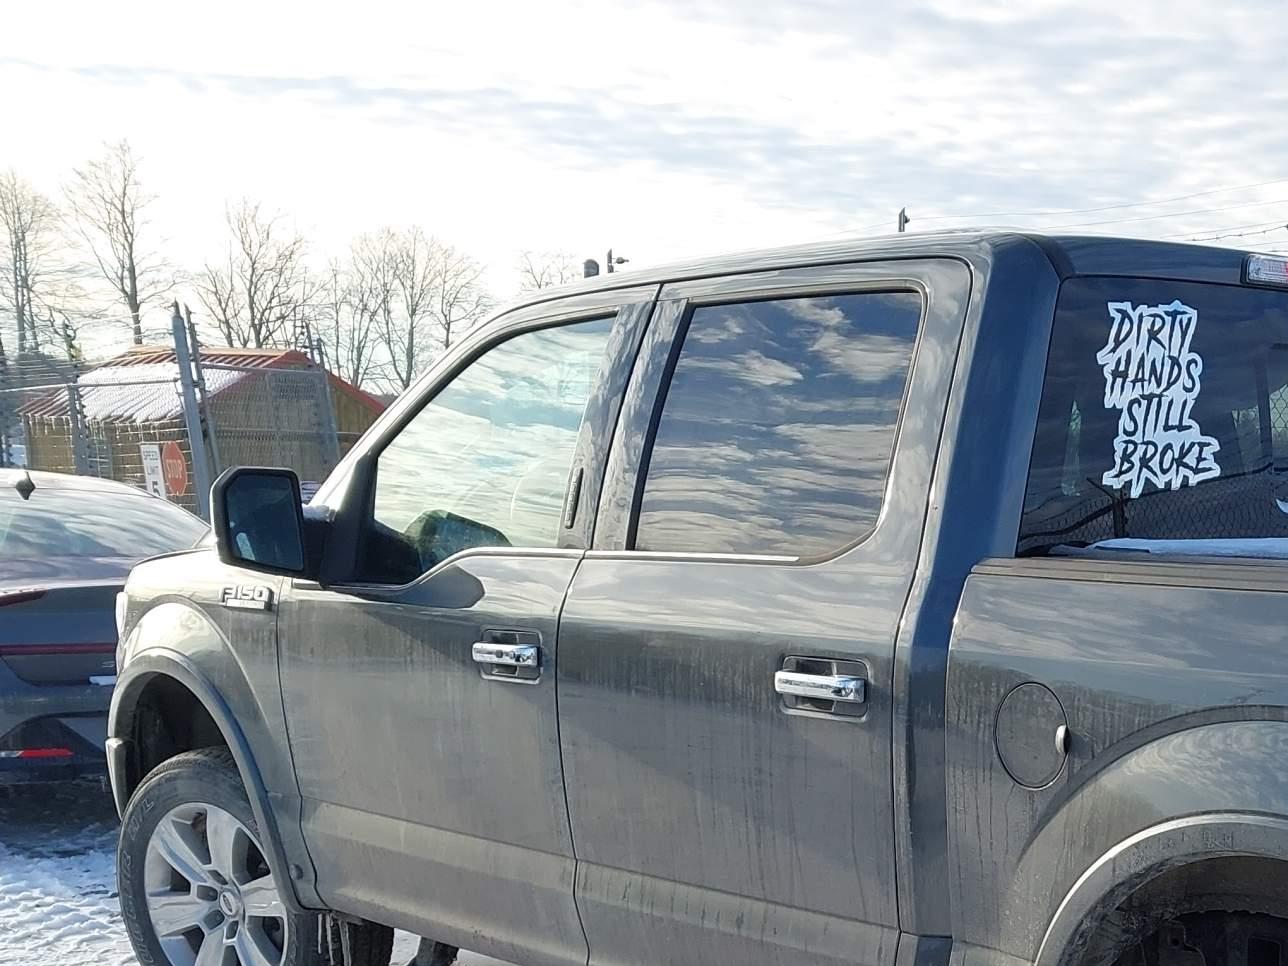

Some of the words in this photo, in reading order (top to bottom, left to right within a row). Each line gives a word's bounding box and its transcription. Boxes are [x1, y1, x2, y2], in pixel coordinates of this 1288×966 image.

[1110, 307, 1194, 354] DIRTY
[1109, 352, 1198, 394] HANDS
[1122, 392, 1192, 442] STILL
[165, 458, 183, 479] STOP
[1109, 438, 1217, 481] BROKE
[151, 480, 161, 497] 5
